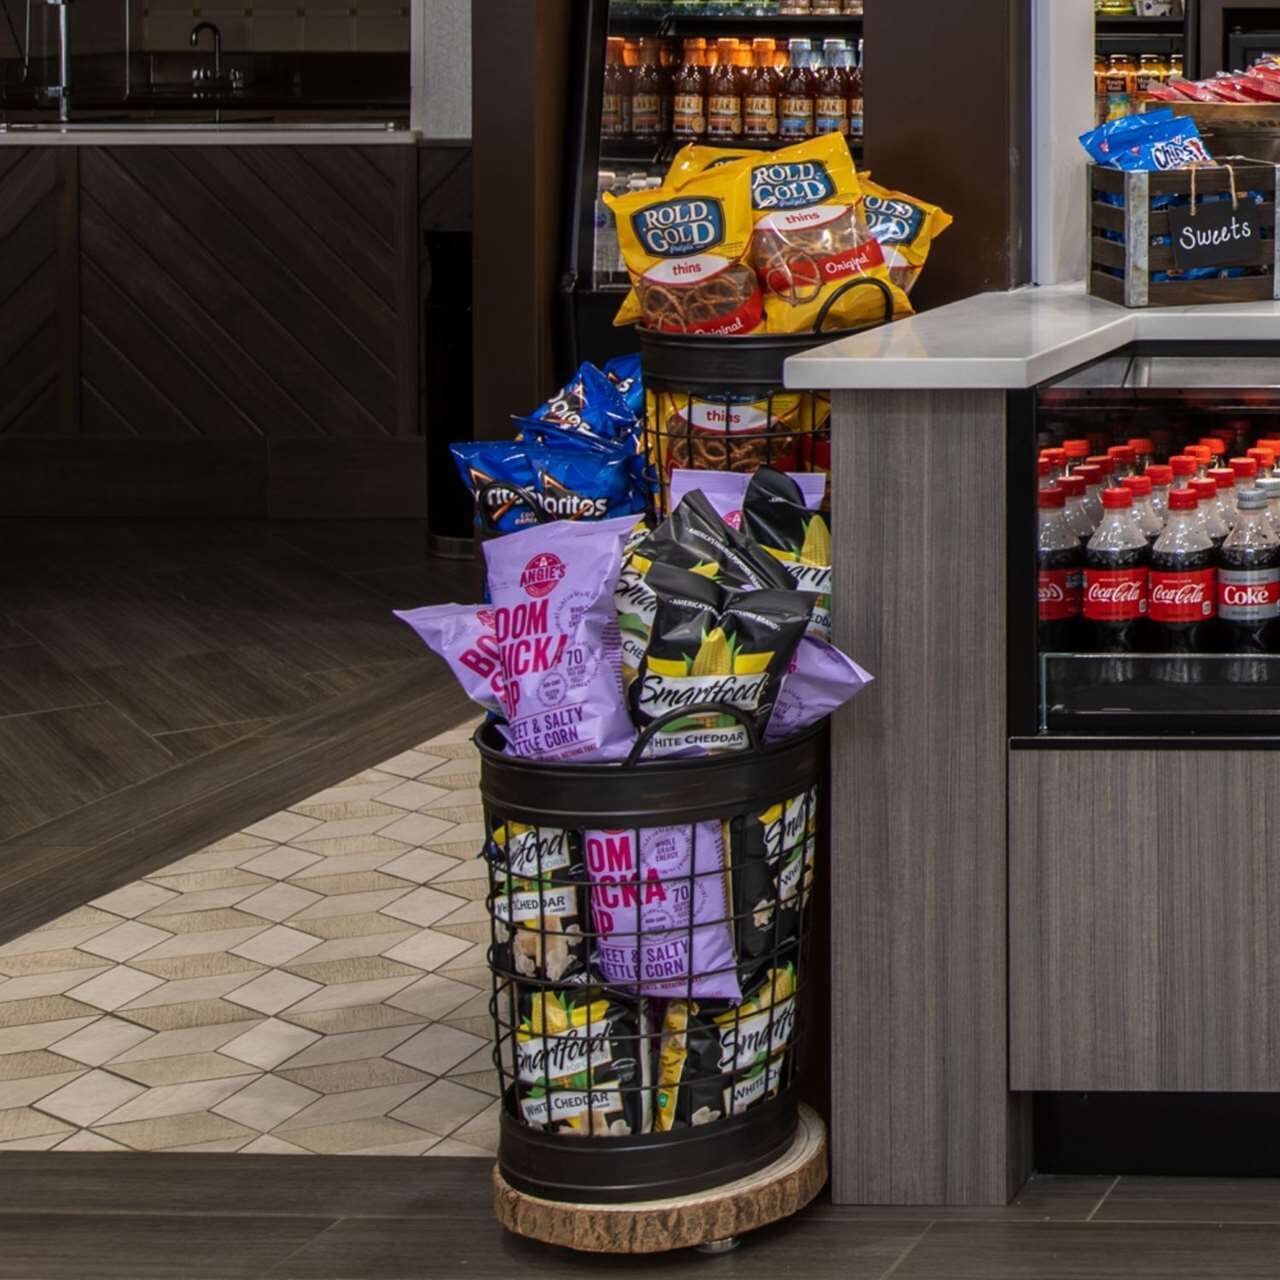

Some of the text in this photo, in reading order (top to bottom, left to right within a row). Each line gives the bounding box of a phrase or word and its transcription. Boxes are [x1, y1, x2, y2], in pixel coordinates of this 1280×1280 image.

[751, 161, 817, 188] ROLD
[751, 180, 827, 209] GOLD
[645, 198, 714, 232] ROLD
[785, 210, 819, 225] thins
[645, 220, 716, 254] GOLD
[1179, 216, 1252, 250] Sweets
[671, 260, 702, 275] thins
[824, 255, 870, 275] Original
[519, 563, 568, 589] ANGIE'S
[1223, 585, 1269, 606] Coke
[566, 648, 583, 666] 70
[640, 674, 766, 708] Smartfood
[544, 706, 584, 732] SALTY
[544, 726, 579, 749] CORN
[684, 732, 744, 747] CHEDDAR
[645, 959, 685, 977] CORN
